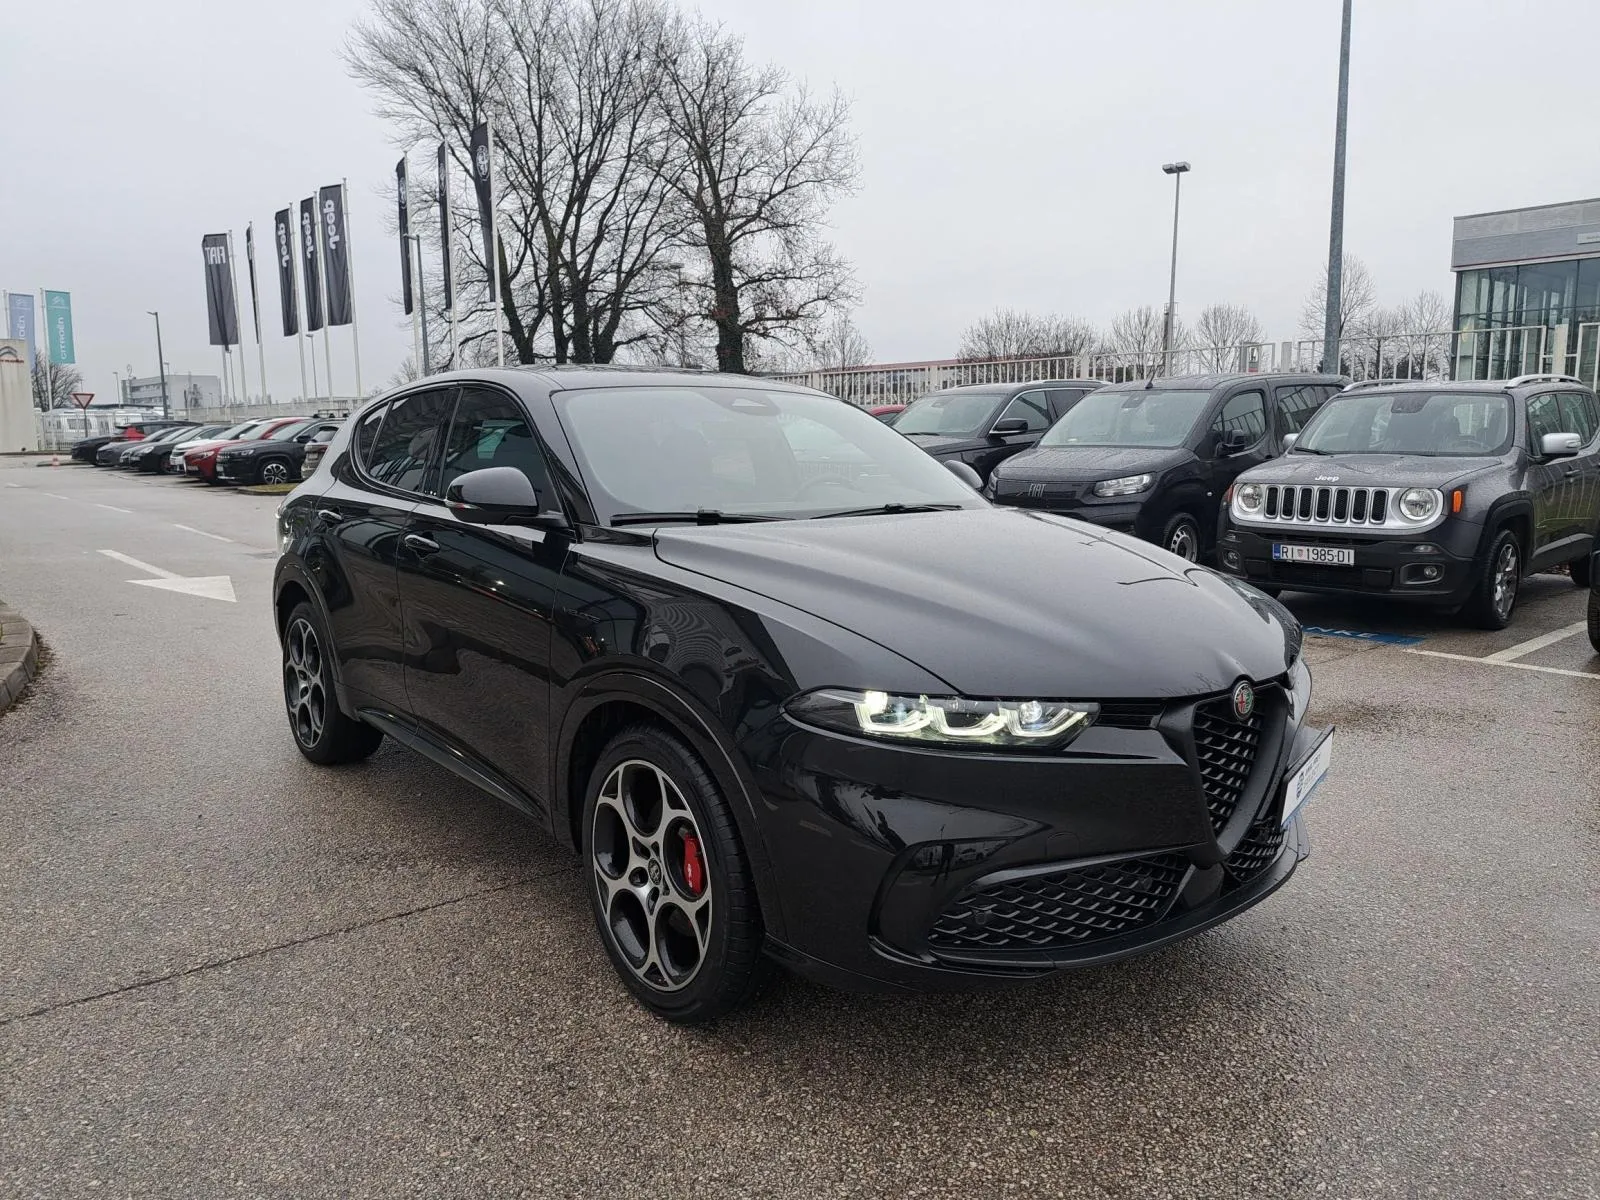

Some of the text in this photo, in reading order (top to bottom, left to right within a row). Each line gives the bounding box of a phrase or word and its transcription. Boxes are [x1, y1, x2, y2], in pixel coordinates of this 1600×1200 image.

[1314, 474, 1340, 483] Jeep
[1027, 483, 1047, 497] FIAT
[1281, 546, 1294, 559] RI
